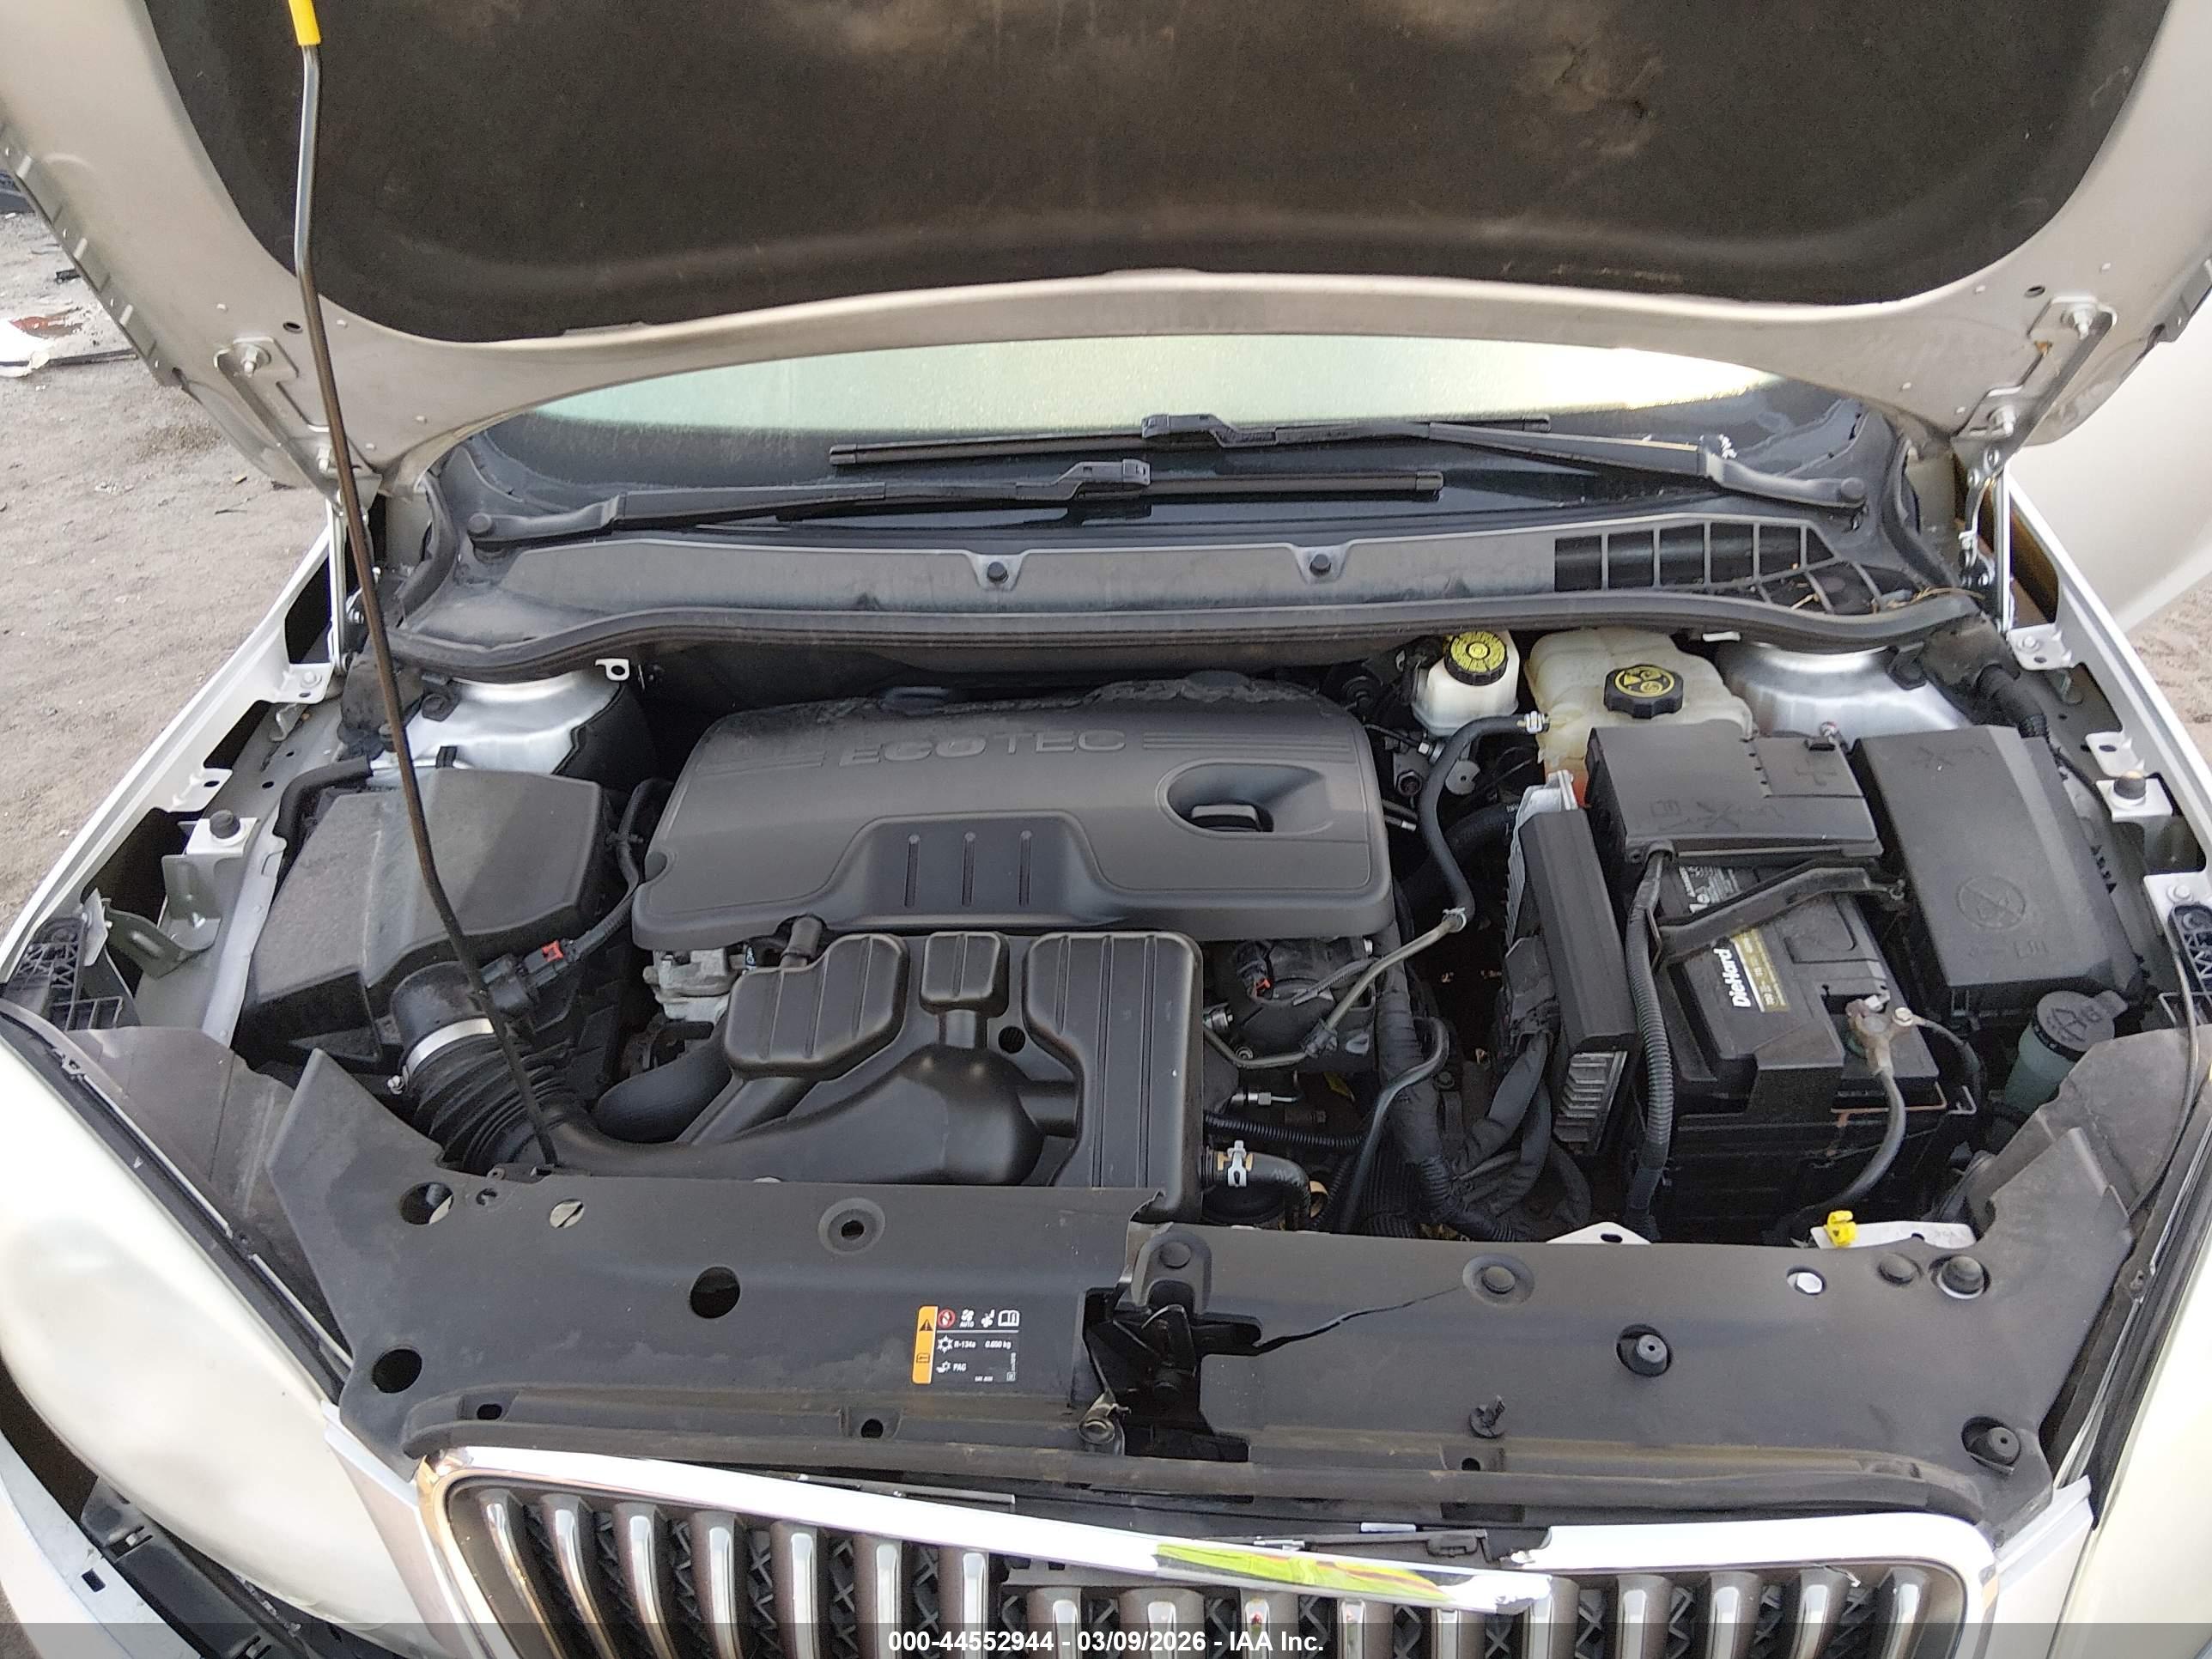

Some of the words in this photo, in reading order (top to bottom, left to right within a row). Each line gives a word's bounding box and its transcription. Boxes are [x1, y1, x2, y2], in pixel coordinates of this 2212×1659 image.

[839, 729, 1127, 767] ECOTEC
[1713, 947, 1752, 1008] DieHard
[953, 1363, 967, 1371] PAG
